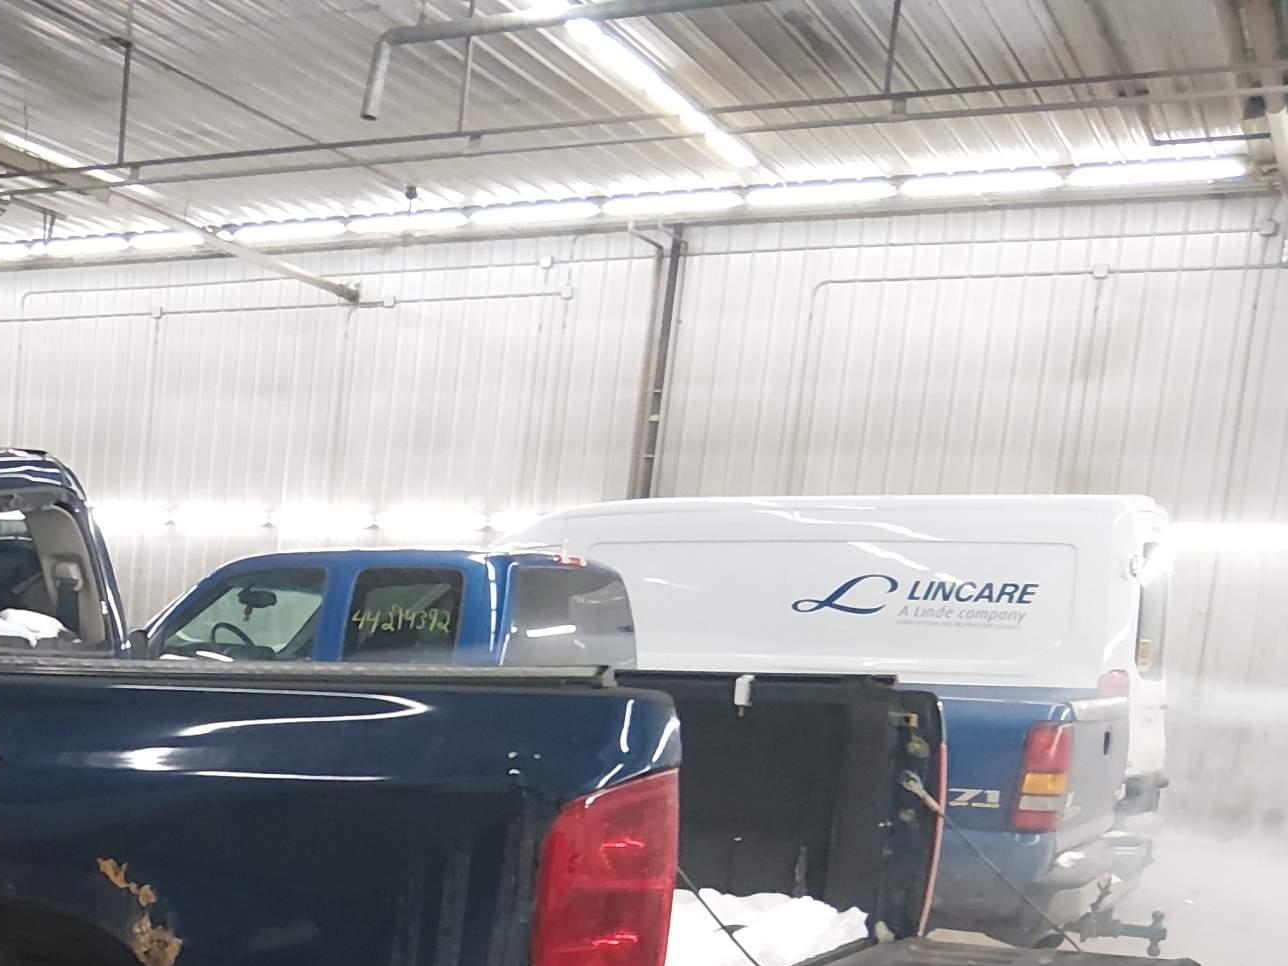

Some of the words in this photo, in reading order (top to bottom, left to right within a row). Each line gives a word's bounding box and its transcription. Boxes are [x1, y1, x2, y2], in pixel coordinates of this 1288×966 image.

[907, 580, 1039, 604] LINCARE
[898, 605, 909, 617] A
[913, 604, 954, 619] Linde
[958, 607, 1027, 624] company
